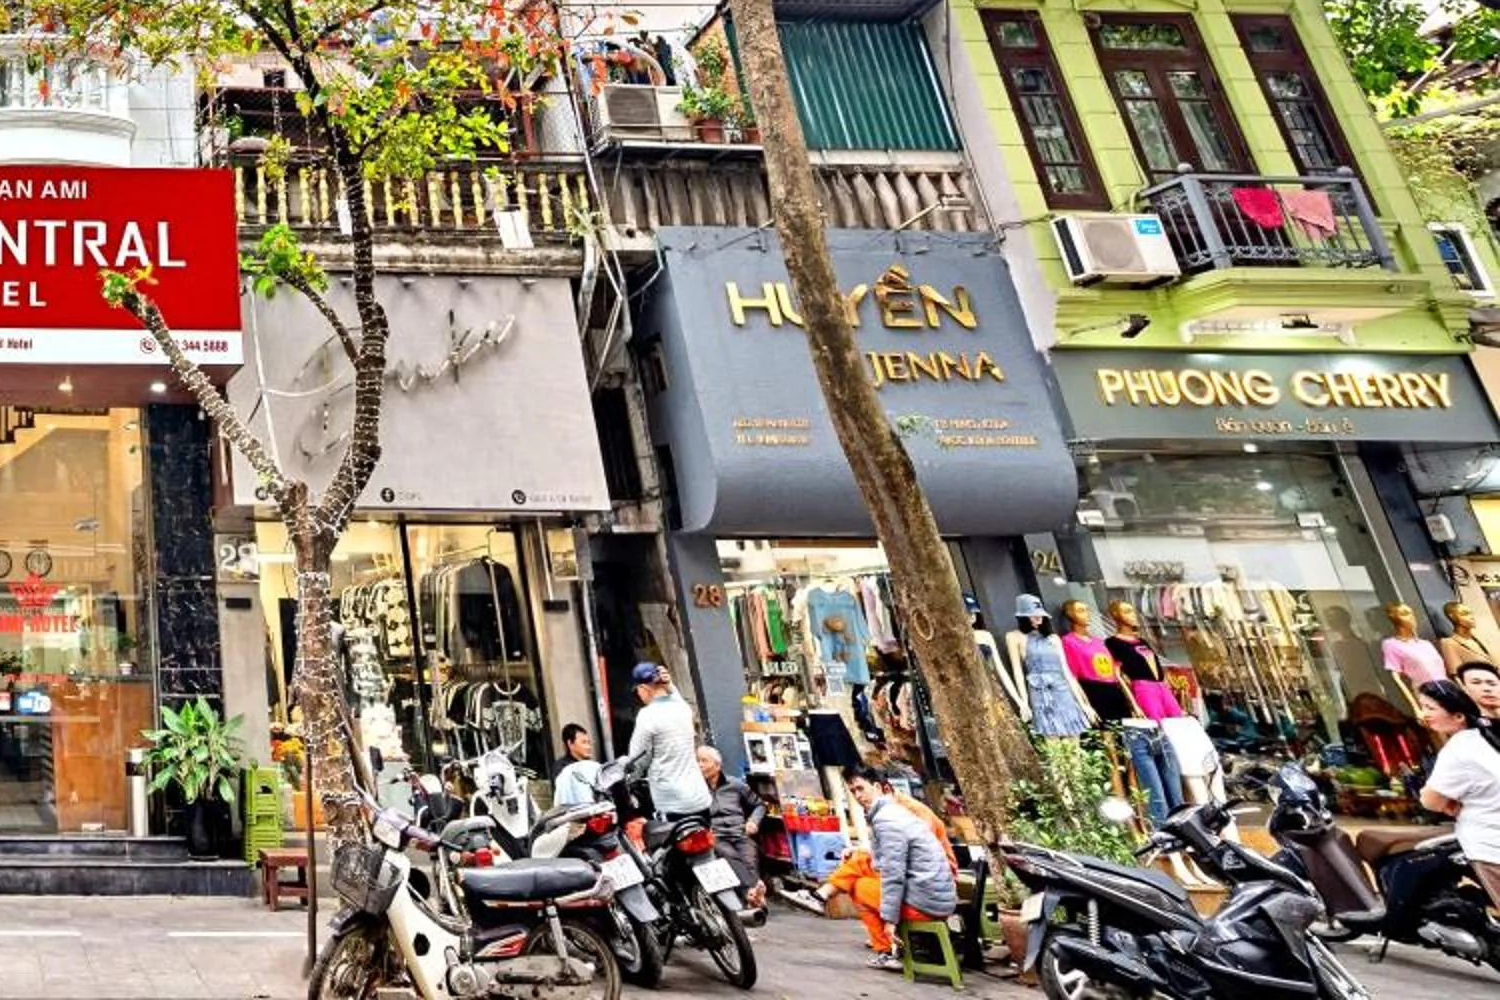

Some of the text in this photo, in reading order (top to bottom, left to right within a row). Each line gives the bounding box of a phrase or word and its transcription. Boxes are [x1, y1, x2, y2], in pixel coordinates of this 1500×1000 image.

[40, 179, 88, 199] AMI
[867, 350, 1005, 388] JENNA
[1292, 370, 1454, 410] CHERRY
[1032, 551, 1061, 575] 24
